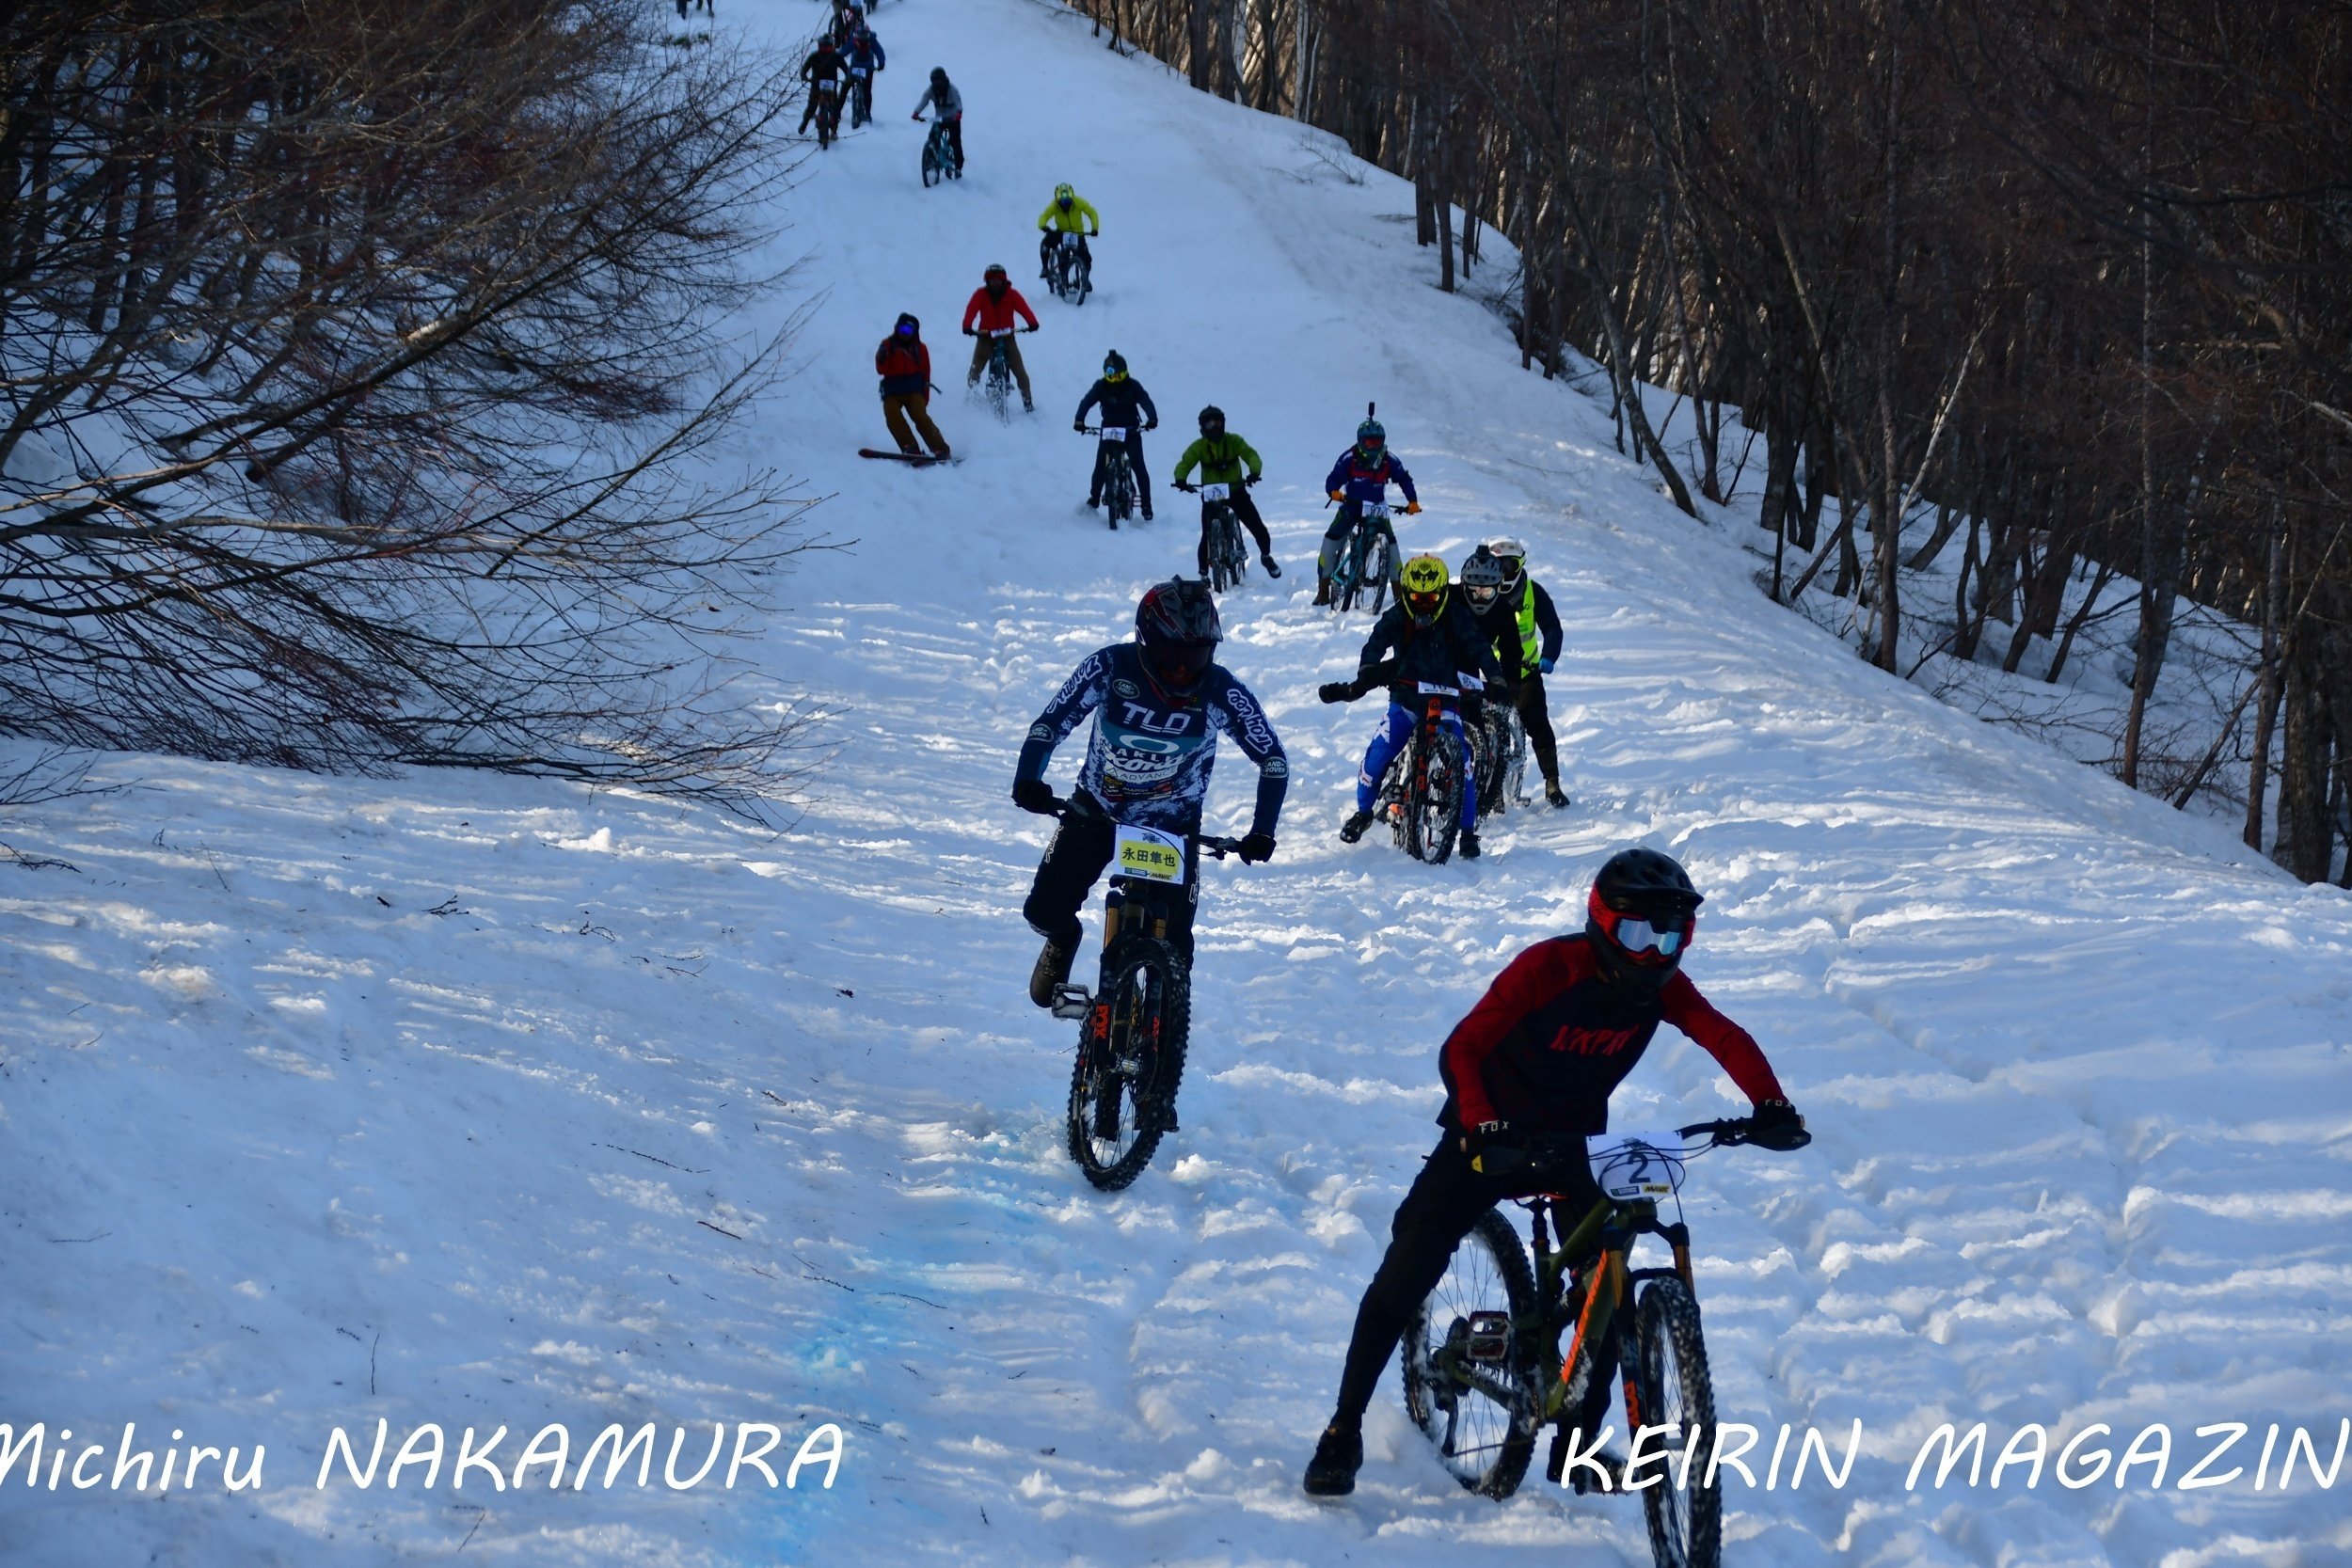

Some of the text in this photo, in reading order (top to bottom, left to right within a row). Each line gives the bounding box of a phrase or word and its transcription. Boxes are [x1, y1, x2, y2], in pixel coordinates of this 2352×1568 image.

[1122, 701, 1191, 735] TLD
[1122, 847, 1176, 867] 永田隼也
[1480, 1120, 1510, 1134] FOX
[1627, 1151, 1651, 1184] 2
